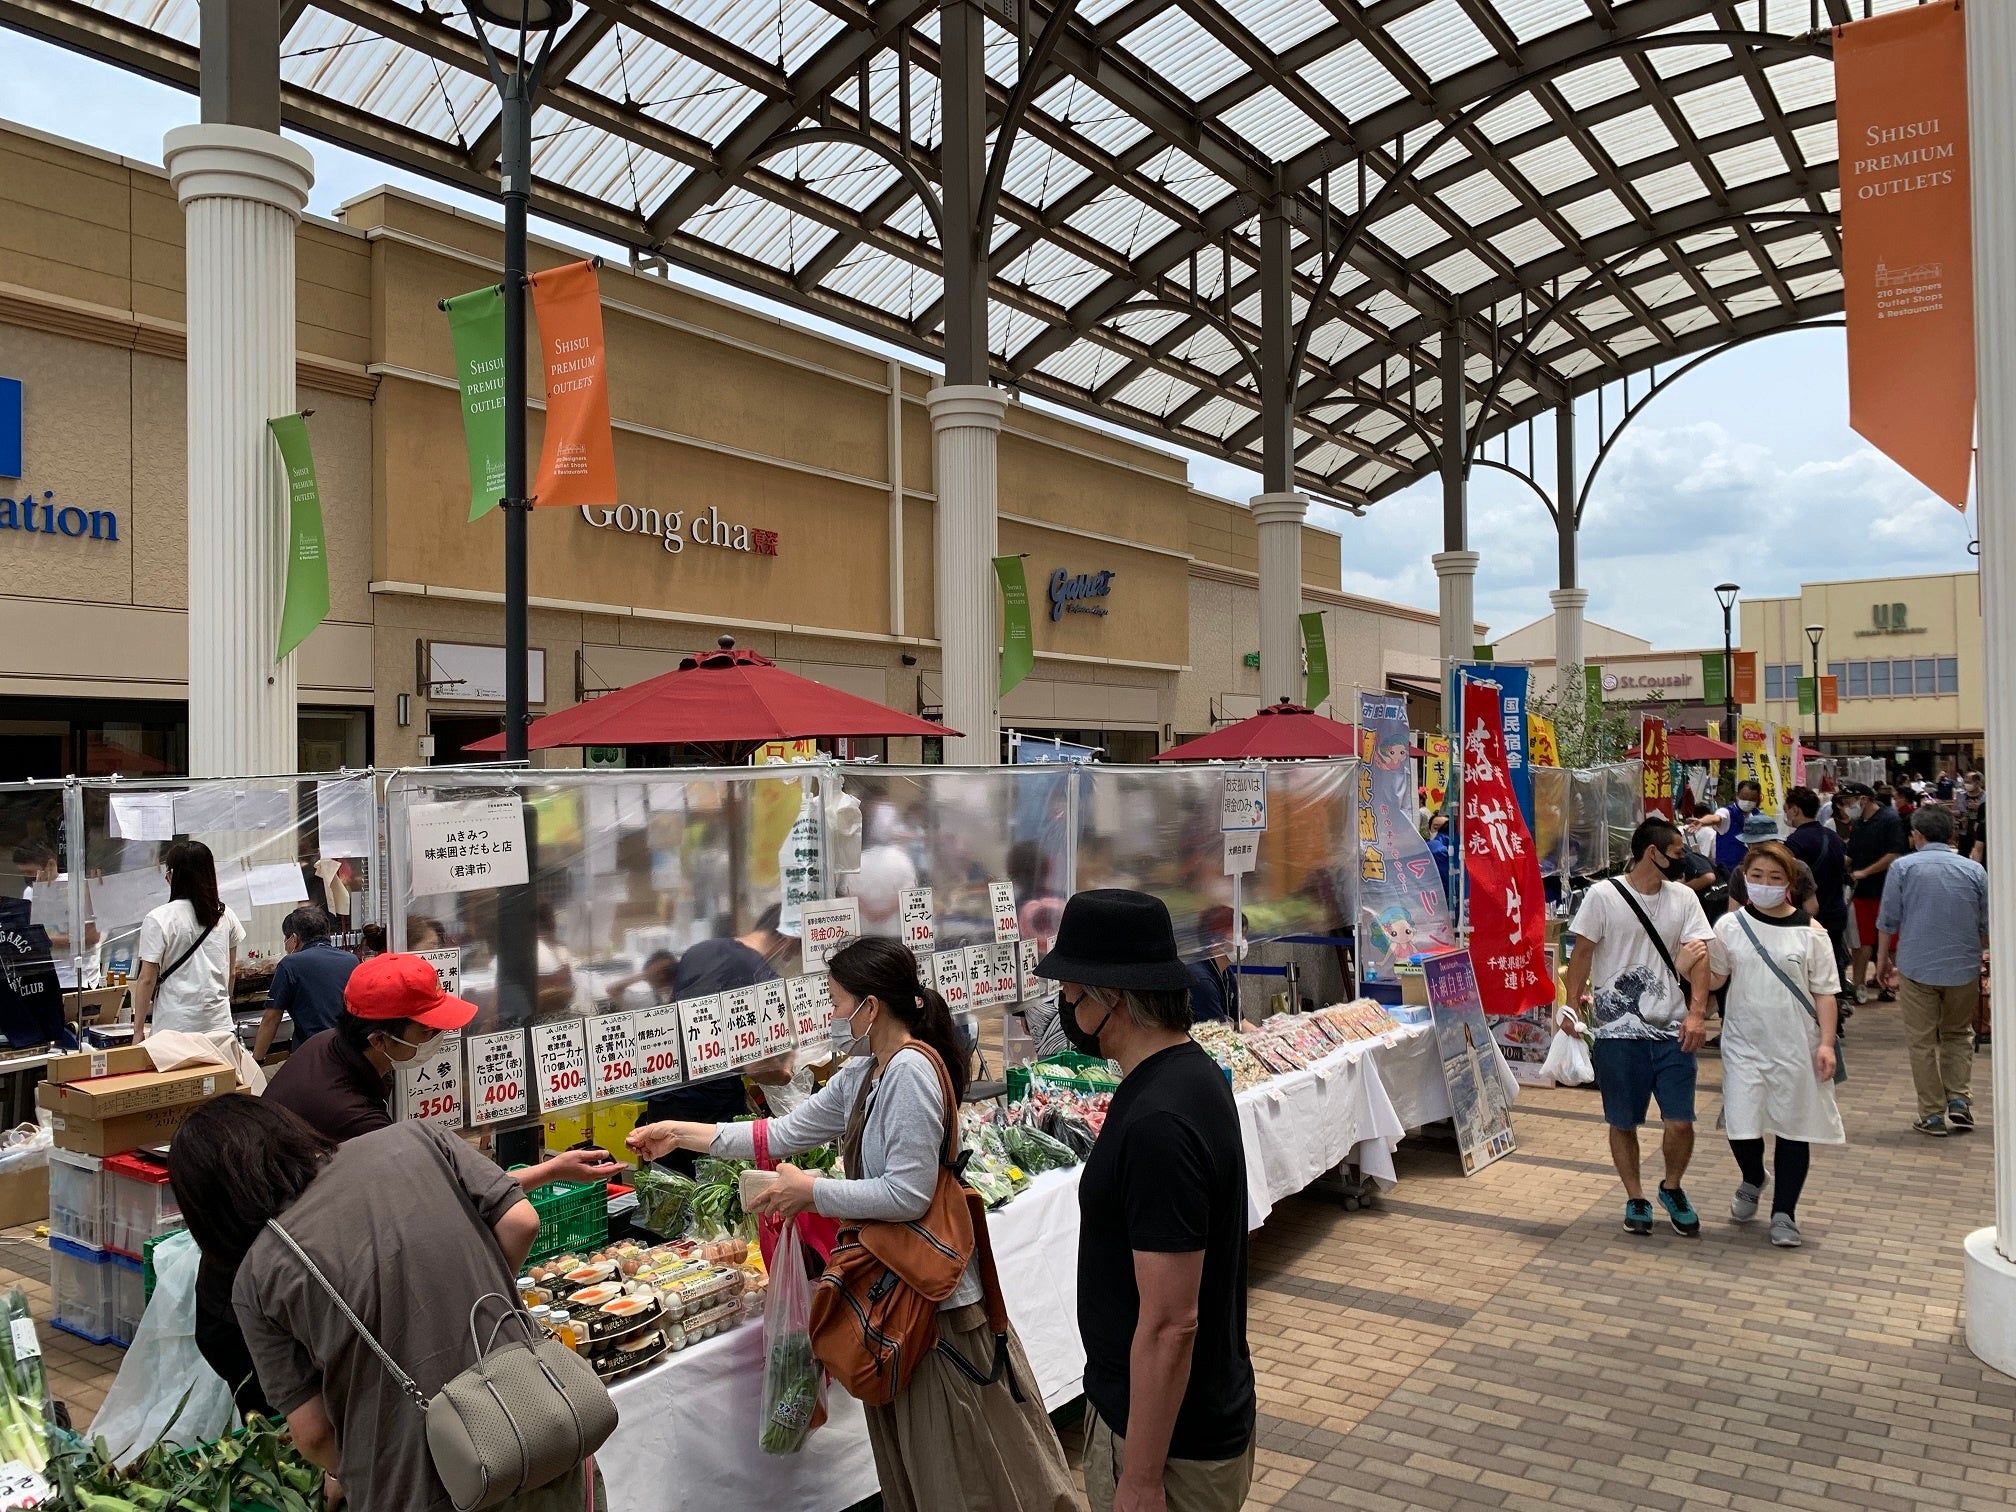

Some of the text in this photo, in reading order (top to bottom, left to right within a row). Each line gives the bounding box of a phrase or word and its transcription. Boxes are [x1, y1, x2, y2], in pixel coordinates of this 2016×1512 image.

[1866, 119, 1940, 147] SHISUI
[1854, 143, 1954, 175] PREMIUM
[1858, 170, 1955, 200] OUTLETS
[1877, 283, 1942, 299] 210 Designers
[1877, 292, 1943, 309] Outlet Shops
[1877, 303, 1943, 319] & Restaurants
[551, 355, 596, 376] PREMIUM
[467, 376, 505, 396] PREMIU
[553, 376, 593, 395] OUTLETS
[470, 397, 505, 414] OUTLET
[0, 490, 120, 541] ation
[581, 504, 684, 553] Gong
[692, 506, 750, 551] cha
[1873, 603, 1907, 629] UR
[1620, 673, 1693, 689] St.Cousair
[1503, 697, 1522, 769] 国民宿舎
[1226, 779, 1260, 792] お支払いは
[1224, 799, 1252, 813] 現金のみ
[447, 829, 488, 842] JAきみつ
[425, 840, 512, 860] 味楽囲さだもと店
[450, 861, 492, 878] （君津市）
[911, 926, 934, 941] 150円
[993, 961, 1015, 976] トマト
[940, 971, 964, 985] きゅうり
[1431, 968, 1474, 999] 大網白里市
[20, 981, 44, 997] CLUB
[945, 987, 968, 1002] 150円
[727, 1011, 757, 1031] 小松菜
[601, 1031, 625, 1042] 君津市産
[638, 1027, 675, 1041] 情熱カレー
[769, 1022, 790, 1041] 150円
[490, 1044, 508, 1053] 千葉県
[547, 1040, 573, 1052] 君津市産
[734, 1031, 761, 1051] 150円
[484, 1051, 513, 1063] 君津市産
[541, 1046, 584, 1063] アローカナ
[597, 1048, 635, 1064] (6個入り)
[697, 1041, 726, 1061] 150円
[476, 1057, 523, 1075] たまご(赤)
[543, 1057, 583, 1074] (10個入り)
[603, 1060, 637, 1082] 250円
[646, 1052, 679, 1074] 200円
[478, 1069, 523, 1086] (10個入り)
[550, 1070, 586, 1093] 500円
[408, 1079, 457, 1097] ジュース(黄)
[485, 1081, 525, 1104] 400円
[419, 1094, 461, 1119] 350円
